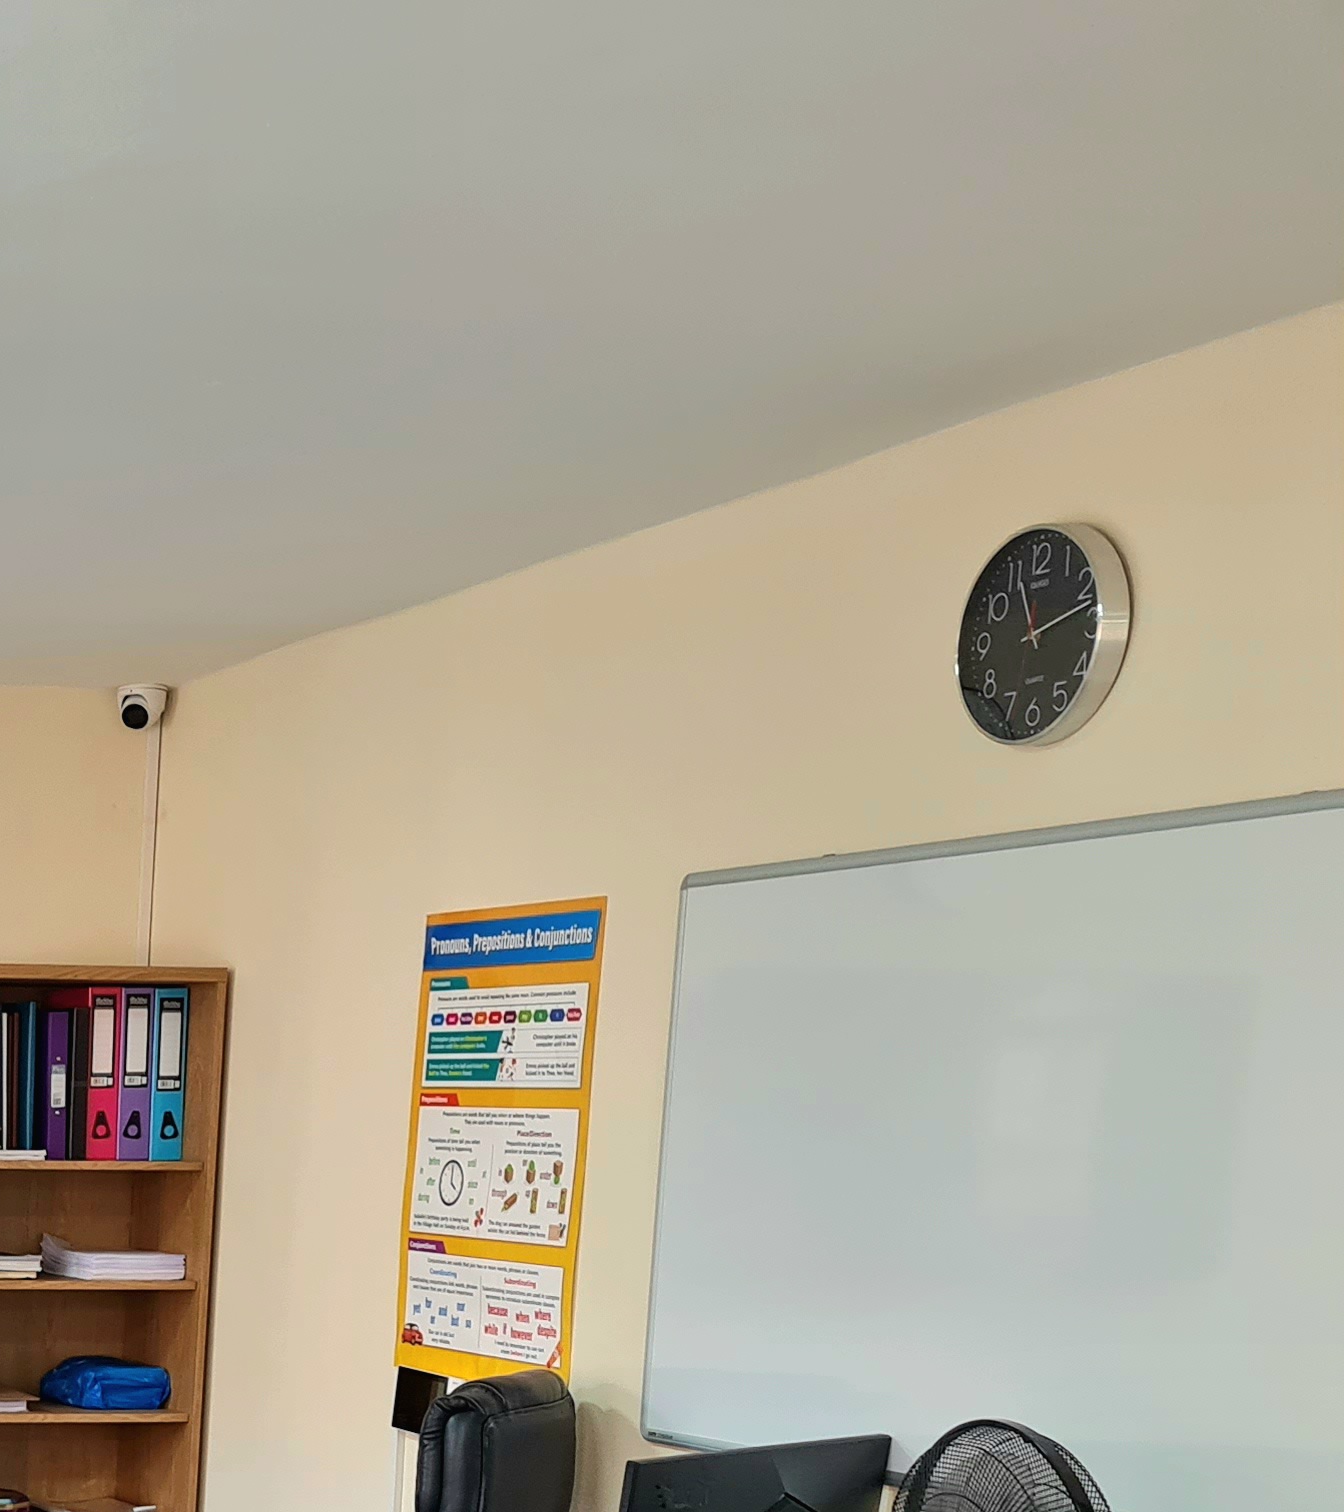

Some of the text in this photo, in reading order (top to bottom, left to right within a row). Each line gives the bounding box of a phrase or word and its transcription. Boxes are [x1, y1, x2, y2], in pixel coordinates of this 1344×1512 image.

[1032, 542, 1051, 575] 12
[1064, 544, 1071, 577] 1
[1008, 560, 1023, 592] 11
[1077, 566, 1095, 600] 2
[987, 592, 1009, 624] 10
[1084, 606, 1099, 639] 3
[976, 632, 991, 661] 9
[1072, 650, 1088, 676] 4
[983, 668, 997, 699] 8
[1052, 681, 1068, 711] 5
[1004, 691, 1017, 721] 7
[1025, 698, 1040, 727] 6
[431, 924, 594, 956] Pronouns, Prepositions & Conjunctions
